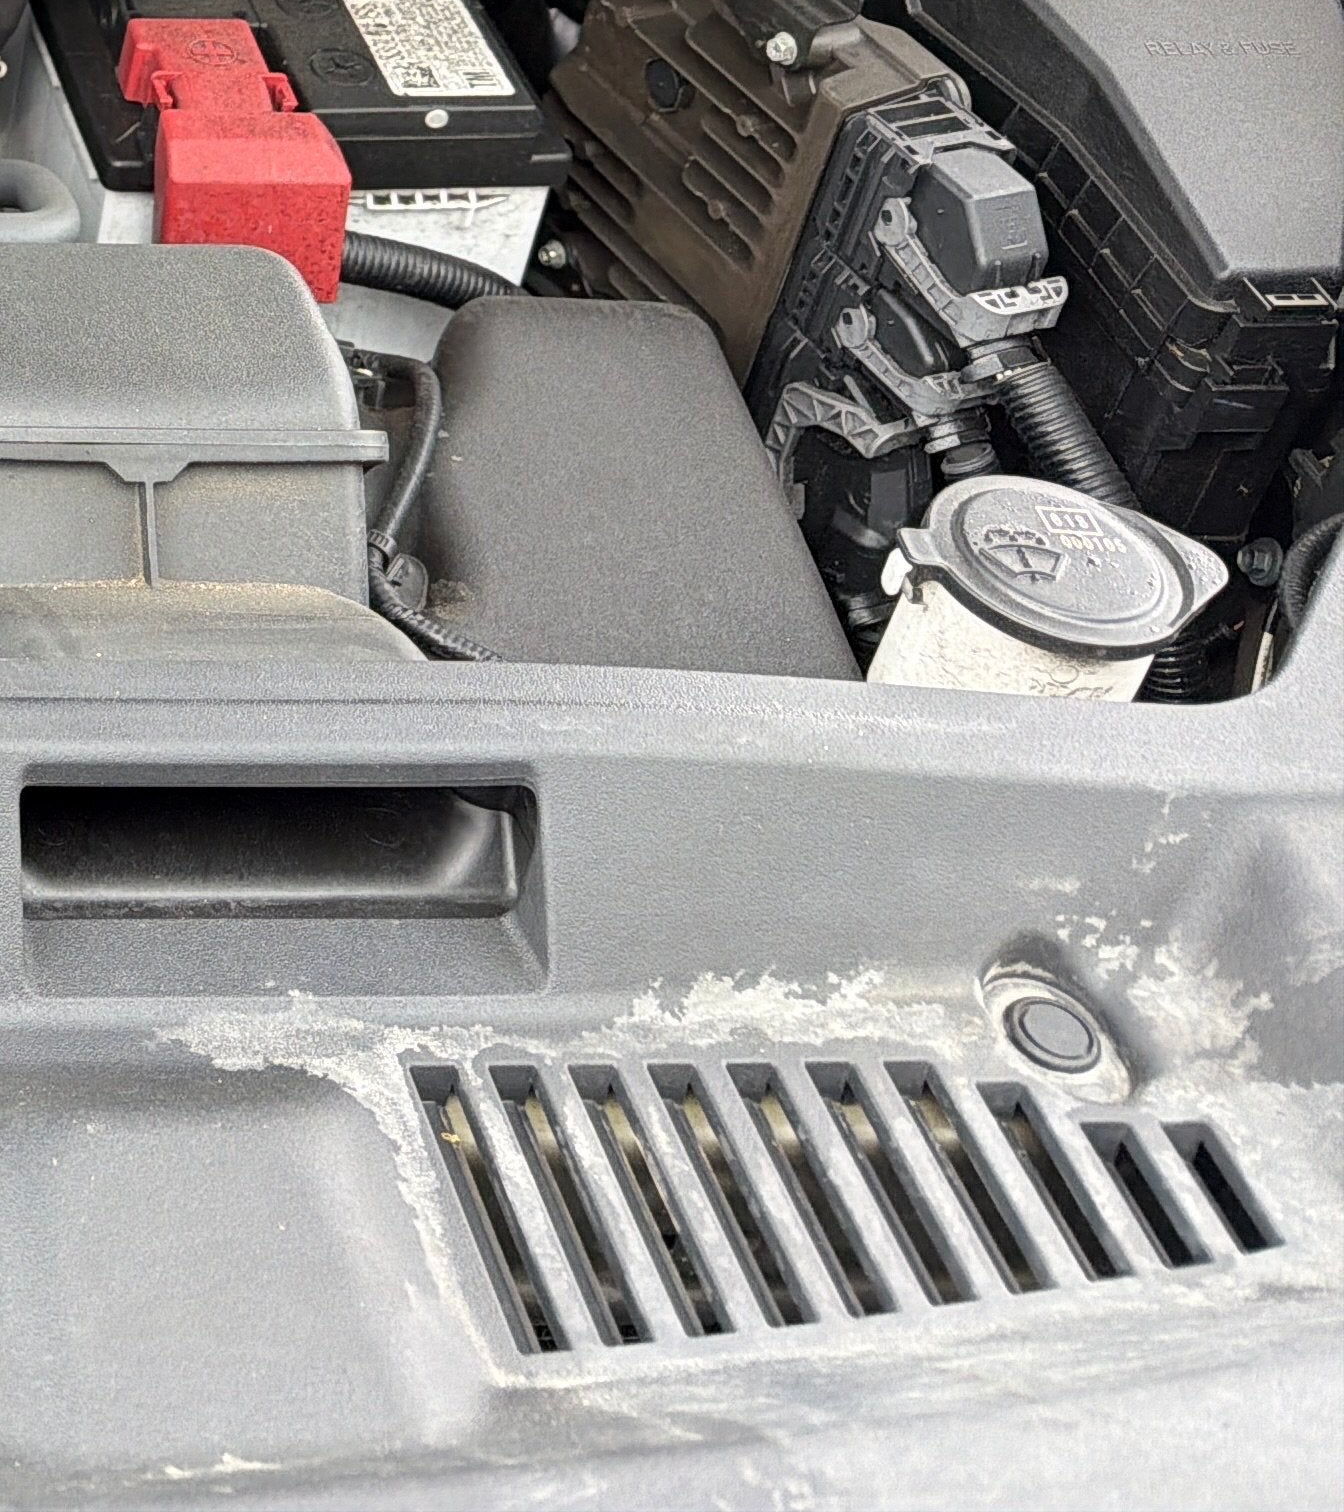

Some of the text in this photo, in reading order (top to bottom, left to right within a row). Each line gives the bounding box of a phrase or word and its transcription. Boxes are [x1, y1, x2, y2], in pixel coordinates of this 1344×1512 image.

[1143, 40, 1301, 57] RELAY & FUSE
